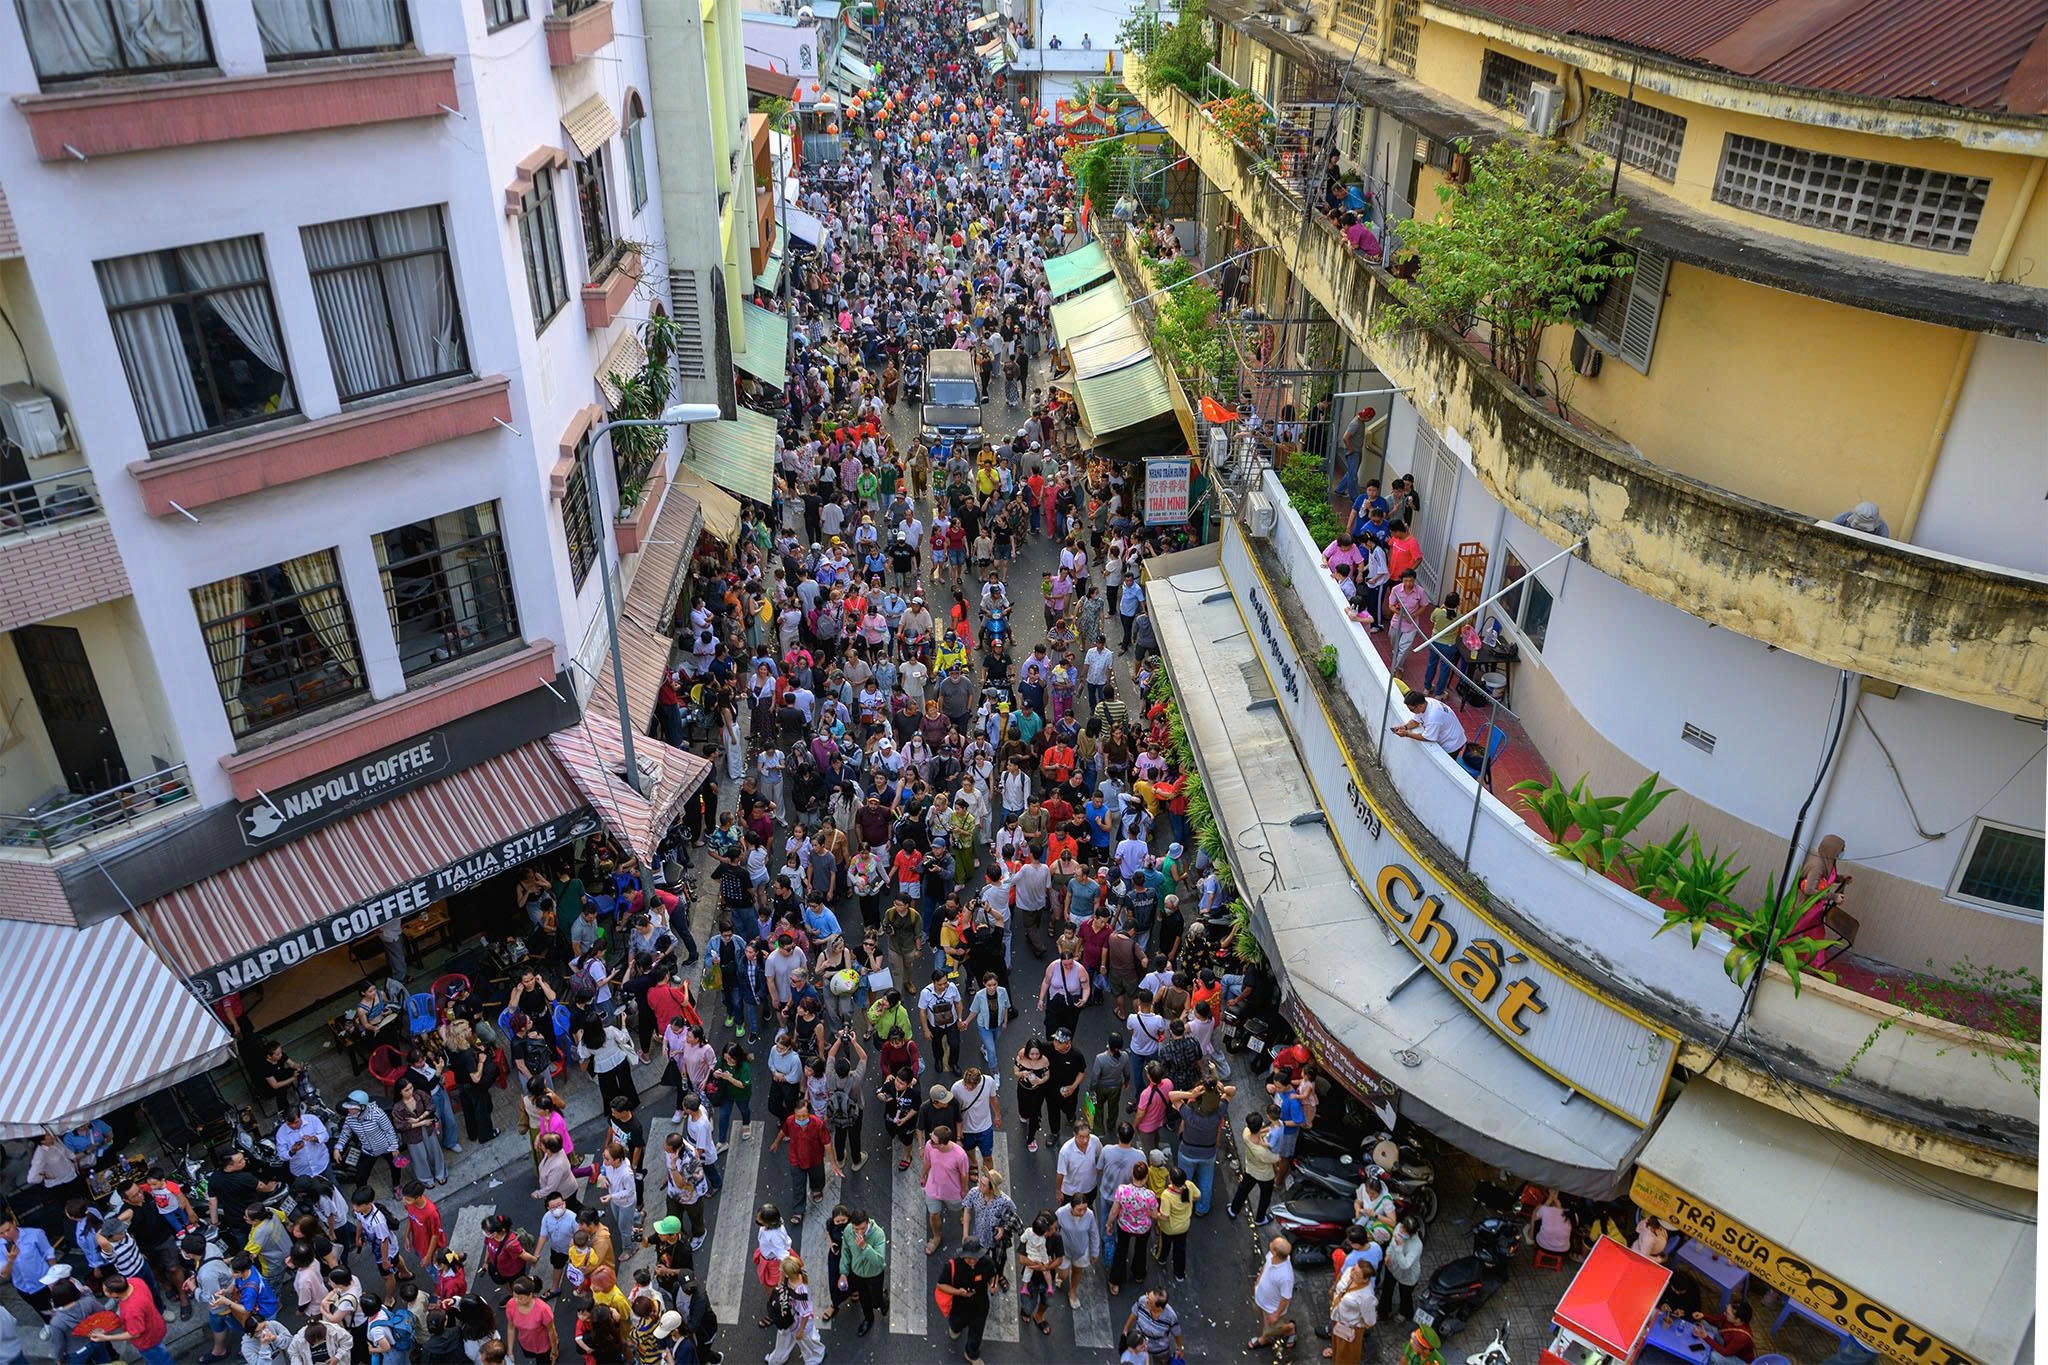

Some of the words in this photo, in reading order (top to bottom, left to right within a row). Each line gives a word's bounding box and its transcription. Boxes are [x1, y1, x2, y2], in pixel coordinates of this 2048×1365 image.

[1167, 496, 1187, 511] MINH
[284, 771, 360, 819] NAPOLI
[361, 741, 434, 787] COFFEE
[360, 783, 387, 798] ITALIA
[400, 768, 423, 781] STYLE
[216, 926, 325, 994] NAPOLI
[331, 881, 430, 943] COFFEE
[436, 852, 498, 889] ITALIA
[502, 825, 557, 860] STYLE
[1376, 863, 1549, 1037] Chất
[1676, 1196, 1717, 1233] TRÀ
[1722, 1226, 1770, 1264] SỮA
[1682, 1223, 1704, 1240] 177A
